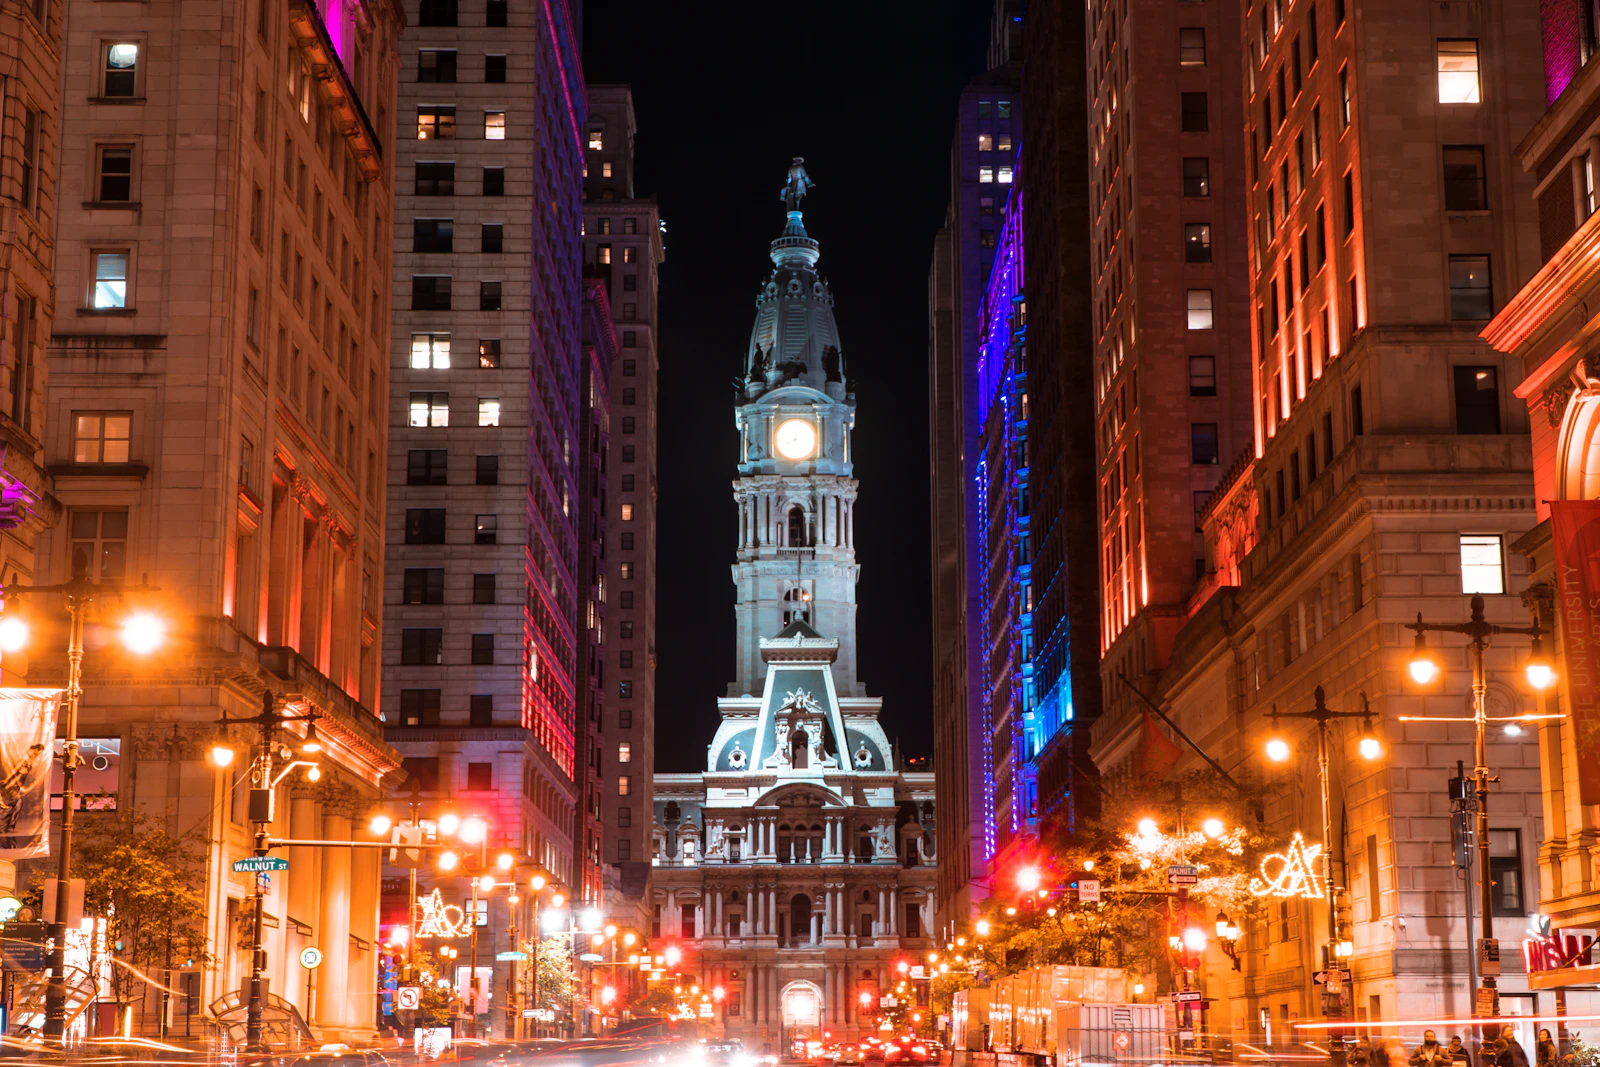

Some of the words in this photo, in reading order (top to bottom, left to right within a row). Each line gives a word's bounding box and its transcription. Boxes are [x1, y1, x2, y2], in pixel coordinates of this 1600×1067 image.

[1562, 564, 1591, 686] UNIVERSITY
[234, 861, 276, 872] WALNUT
[1168, 867, 1191, 875] WALNUT
